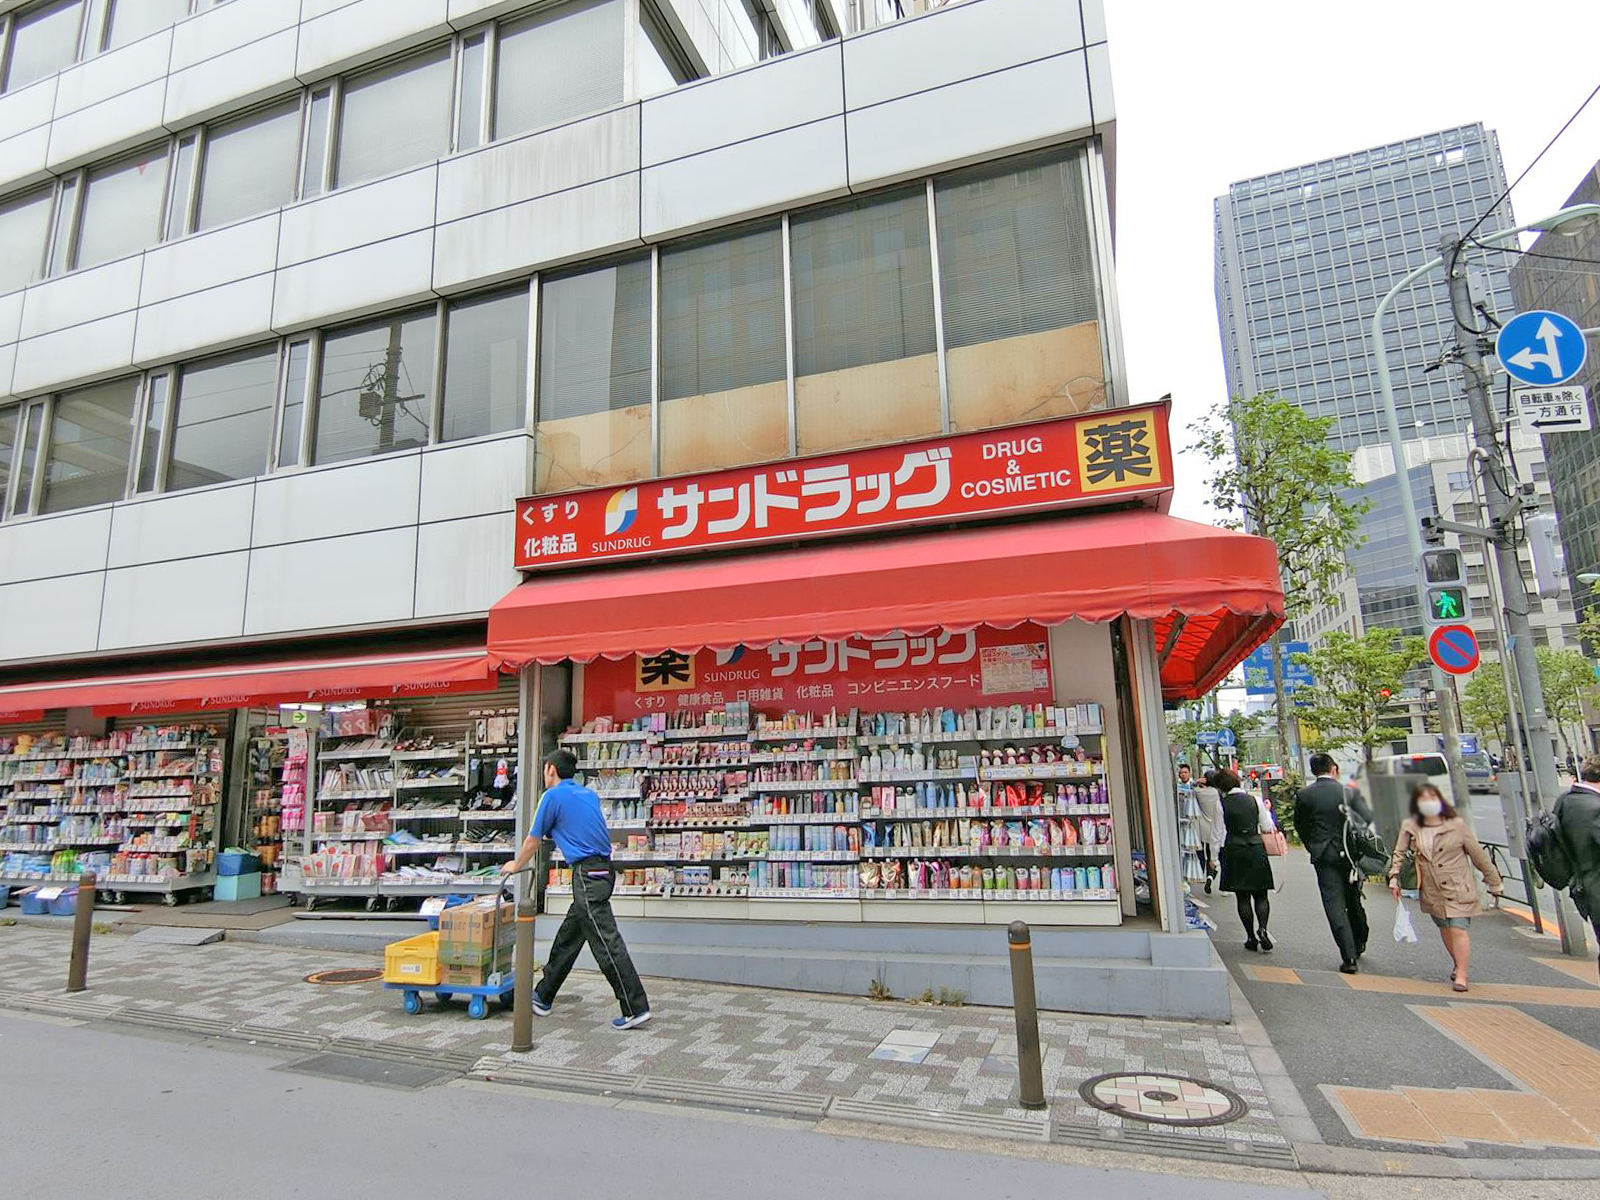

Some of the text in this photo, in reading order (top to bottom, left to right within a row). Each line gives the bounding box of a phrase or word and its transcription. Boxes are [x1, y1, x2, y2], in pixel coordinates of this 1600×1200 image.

[1520, 391, 1581, 405] 自転車を除く
[1523, 405, 1582, 418] 一方通行
[982, 436, 1043, 460] DRUG
[1083, 419, 1153, 485] 薬
[1006, 459, 1021, 475] &
[657, 447, 953, 540] サンドラッグ
[960, 469, 1071, 499] COSMETIC
[522, 500, 579, 526] くすり
[524, 533, 578, 558] 化粧品
[592, 536, 651, 553] SUNDRUG
[704, 669, 760, 683] SUNDRUG
[634, 673, 981, 709] くすり 健康食品 日用雑貨 化粧品 コンビニエンスフード
